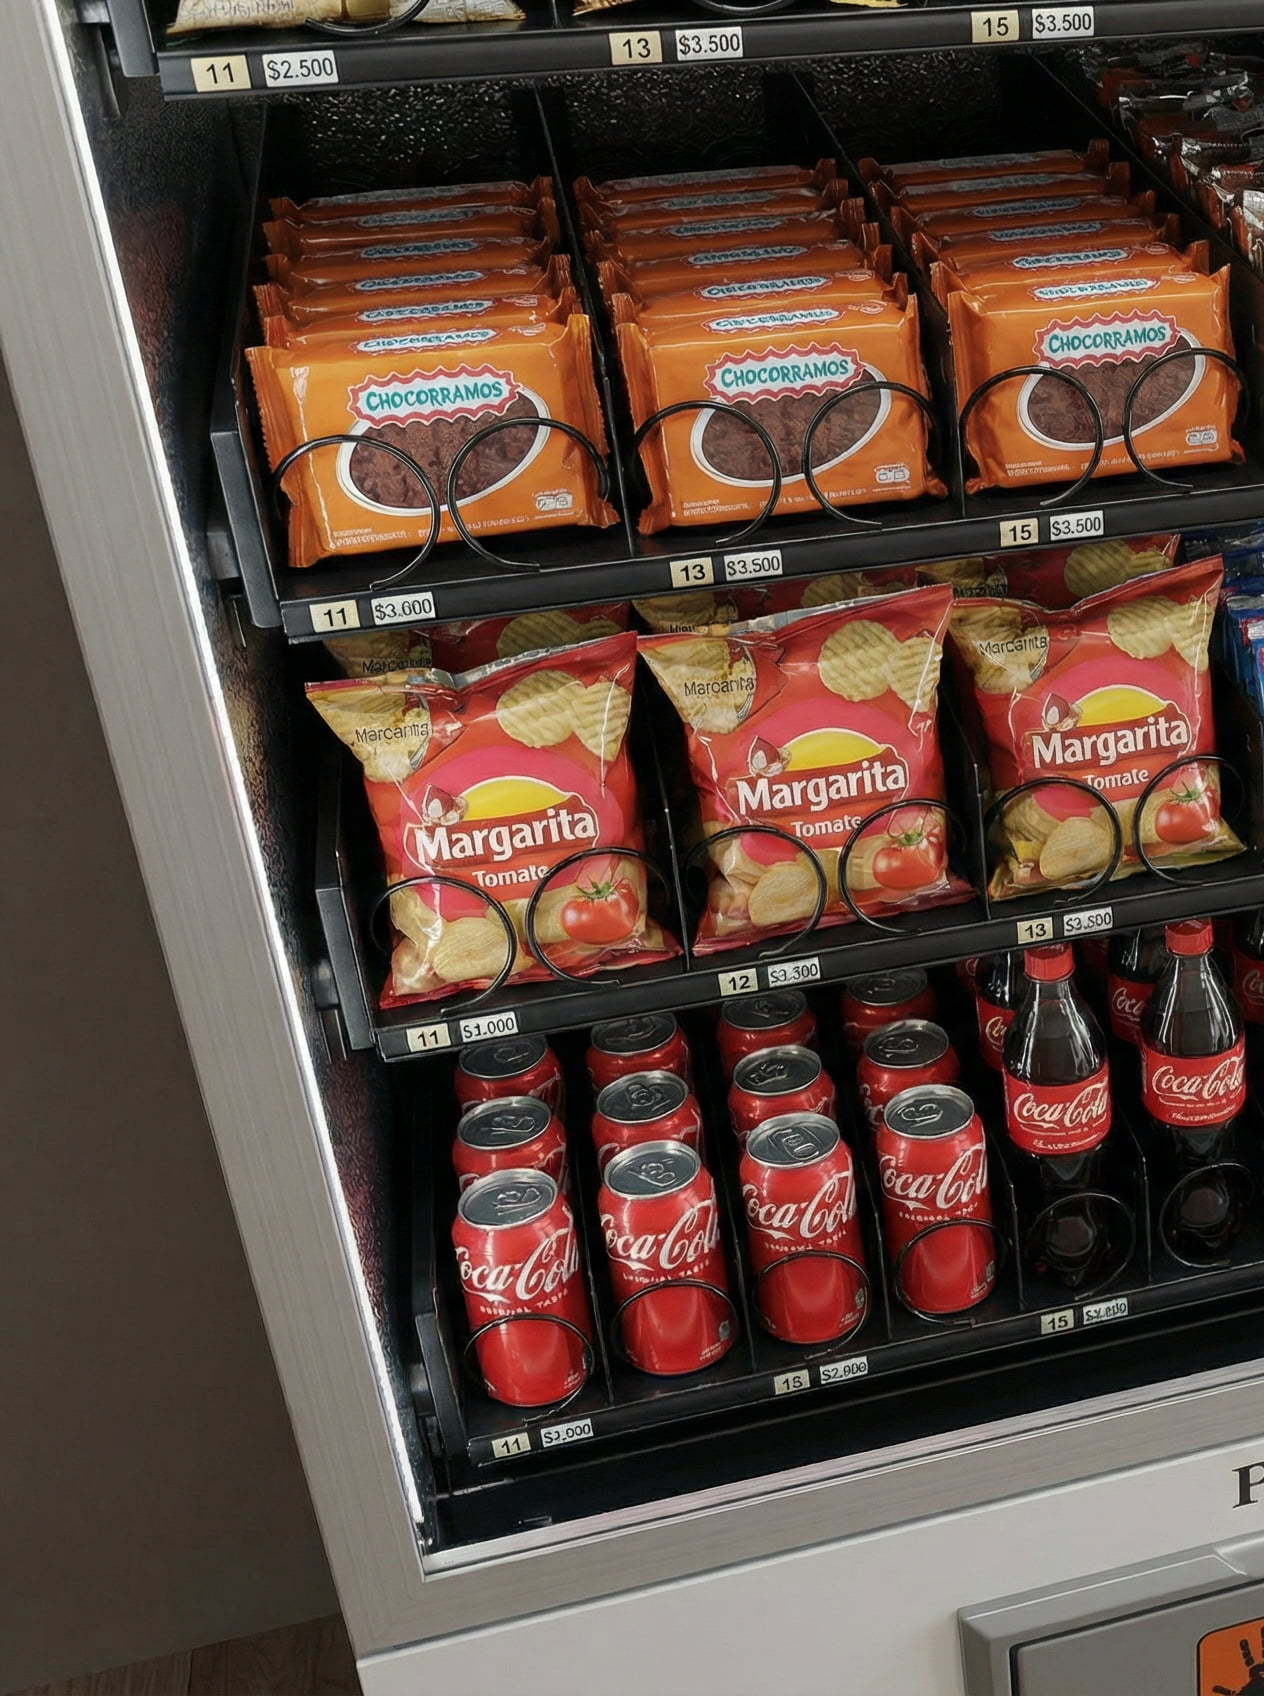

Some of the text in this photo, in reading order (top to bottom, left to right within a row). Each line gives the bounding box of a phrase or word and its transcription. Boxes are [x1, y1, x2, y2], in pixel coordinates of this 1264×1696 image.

[982, 17, 1009, 38] 15
[1033, 12, 1092, 34] $3.500
[621, 38, 652, 60] 13
[678, 33, 741, 57] $3.500
[205, 62, 235, 85] 11
[266, 57, 334, 81] $2.500
[1048, 325, 1167, 354] CHOCORRAMOS
[720, 359, 849, 388] CHOCORRAMOS
[365, 380, 503, 412] CHOCORRAMOS
[1008, 523, 1032, 543] 15
[1051, 516, 1102, 536] $3.500
[680, 563, 706, 583] 13
[323, 607, 348, 627] 11
[1031, 715, 1189, 769] Margarita
[736, 760, 906, 816] Margarita
[1082, 768, 1149, 791] Tomate
[414, 808, 597, 862] Margarita
[790, 814, 863, 838] Tomate
[471, 864, 549, 888] Tomate
[1024, 921, 1047, 939] 13
[727, 974, 752, 992] 12
[416, 1029, 440, 1048] 11
[879, 1141, 988, 1211] Coca-Col
[742, 1169, 857, 1241] Coca-Col
[600, 1198, 720, 1272] Coca-Col
[456, 1226, 579, 1303] Coca-Col
[1046, 1315, 1069, 1331] 15
[500, 1437, 524, 1455] 11
